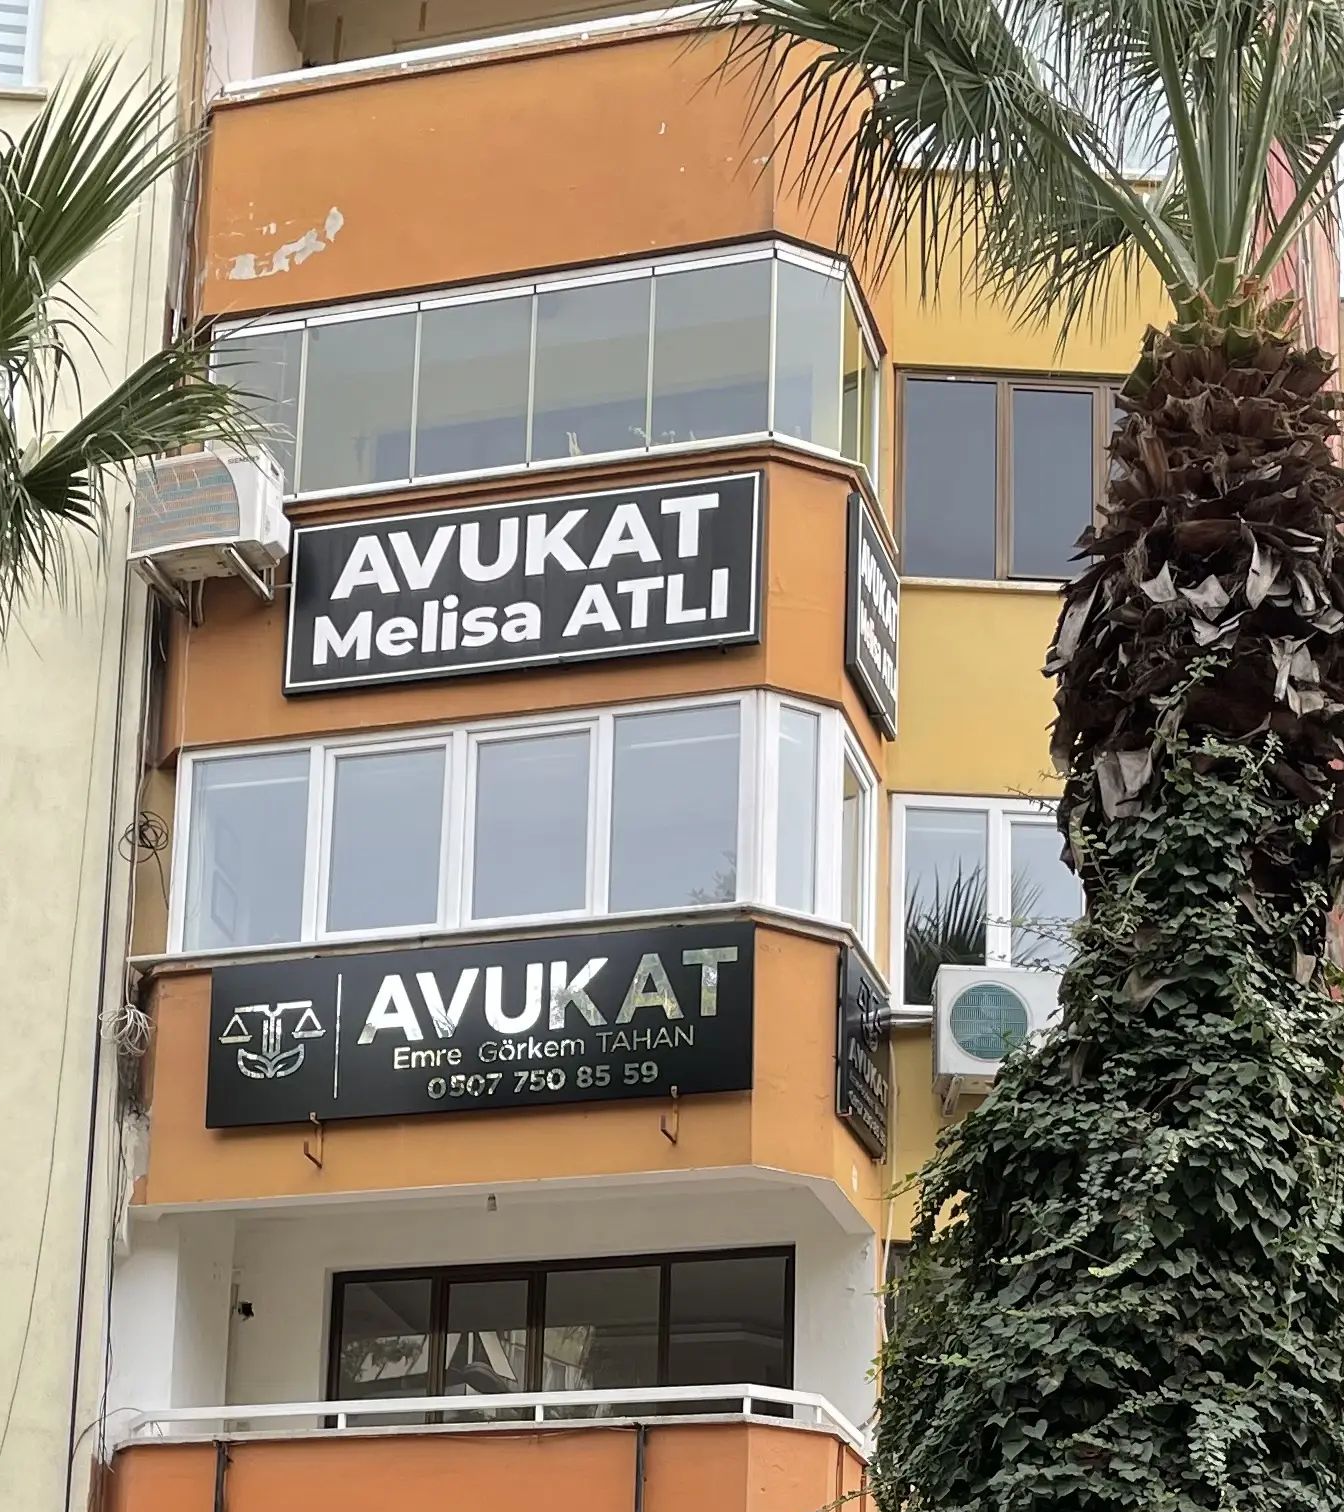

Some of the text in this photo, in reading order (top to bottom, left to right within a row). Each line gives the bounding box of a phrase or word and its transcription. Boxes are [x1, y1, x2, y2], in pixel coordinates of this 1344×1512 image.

[330, 493, 720, 600] AVUKAT
[860, 537, 899, 643] AVUKAT
[312, 567, 730, 665] Melisa ATLI
[357, 946, 739, 1046] AVUKAT
[393, 1025, 695, 1070] Emre Görkem TAHAN
[427, 1060, 659, 1100] 0507 750 85 59
